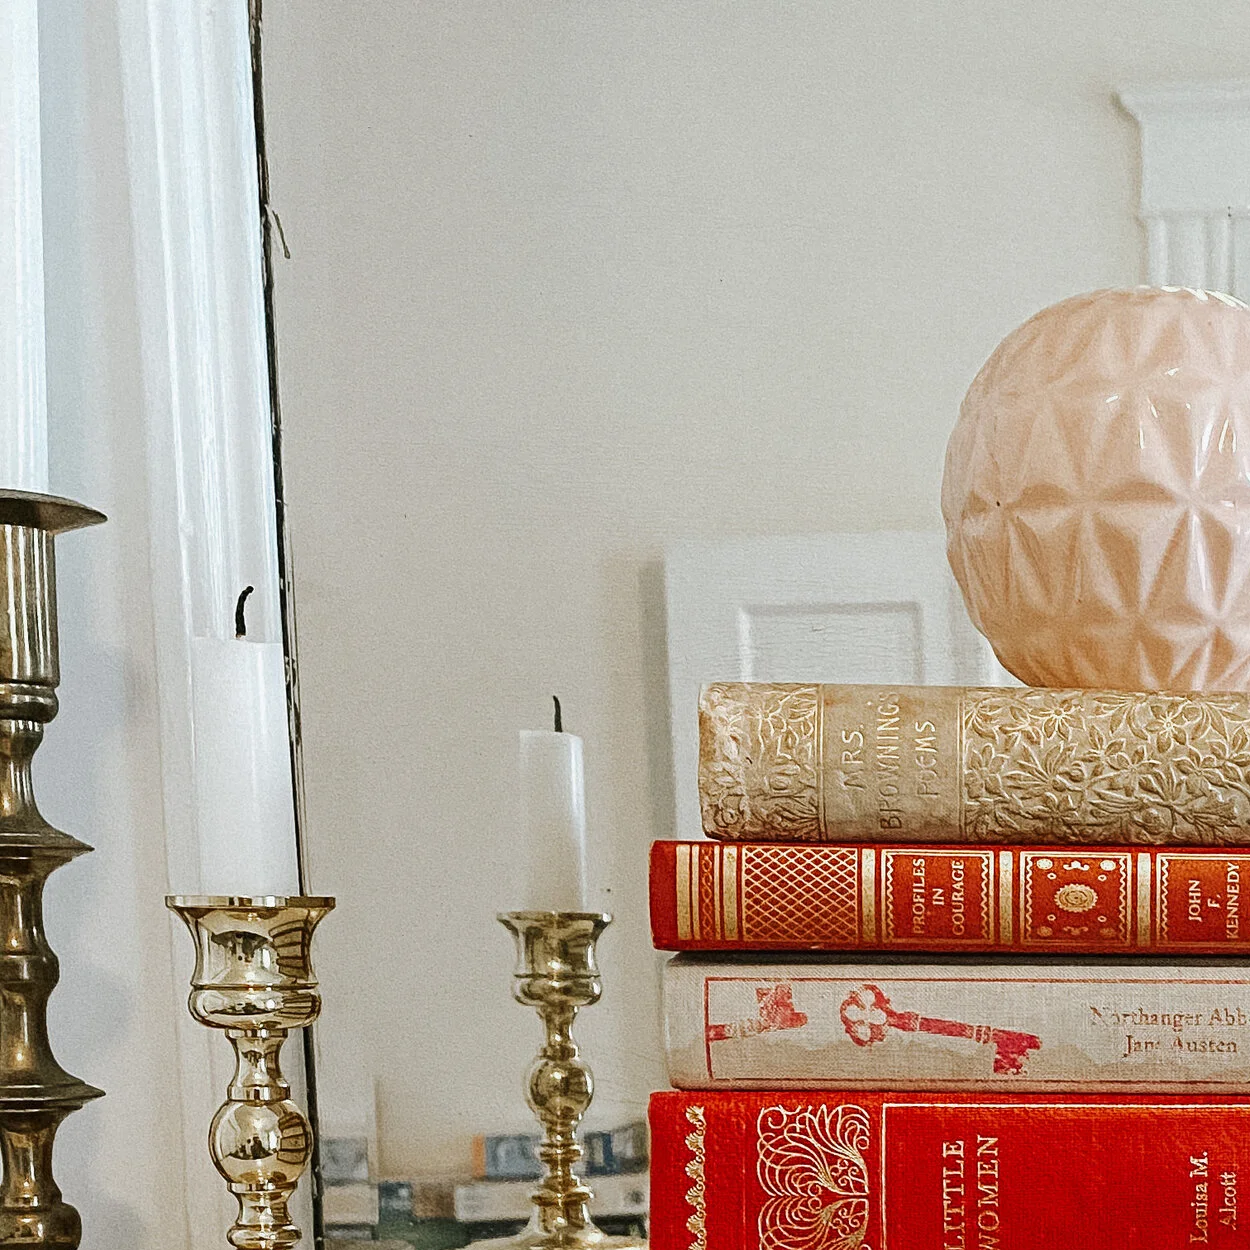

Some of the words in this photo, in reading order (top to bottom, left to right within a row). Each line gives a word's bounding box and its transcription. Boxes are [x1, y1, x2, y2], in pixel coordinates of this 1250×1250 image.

[915, 720, 938, 798] POEMS
[912, 858, 925, 934] PROFILES
[932, 888, 945, 906] IN
[951, 860, 965, 936] COURAGE
[1188, 880, 1202, 922] JOHN
[1207, 894, 1221, 909] F.
[1226, 862, 1240, 939] KENNEDY
[1171, 1036, 1238, 1053] Austen
[1189, 1151, 1208, 1178] M.
[1189, 1182, 1208, 1243] Louisa
[1219, 1172, 1237, 1230] Alcott
